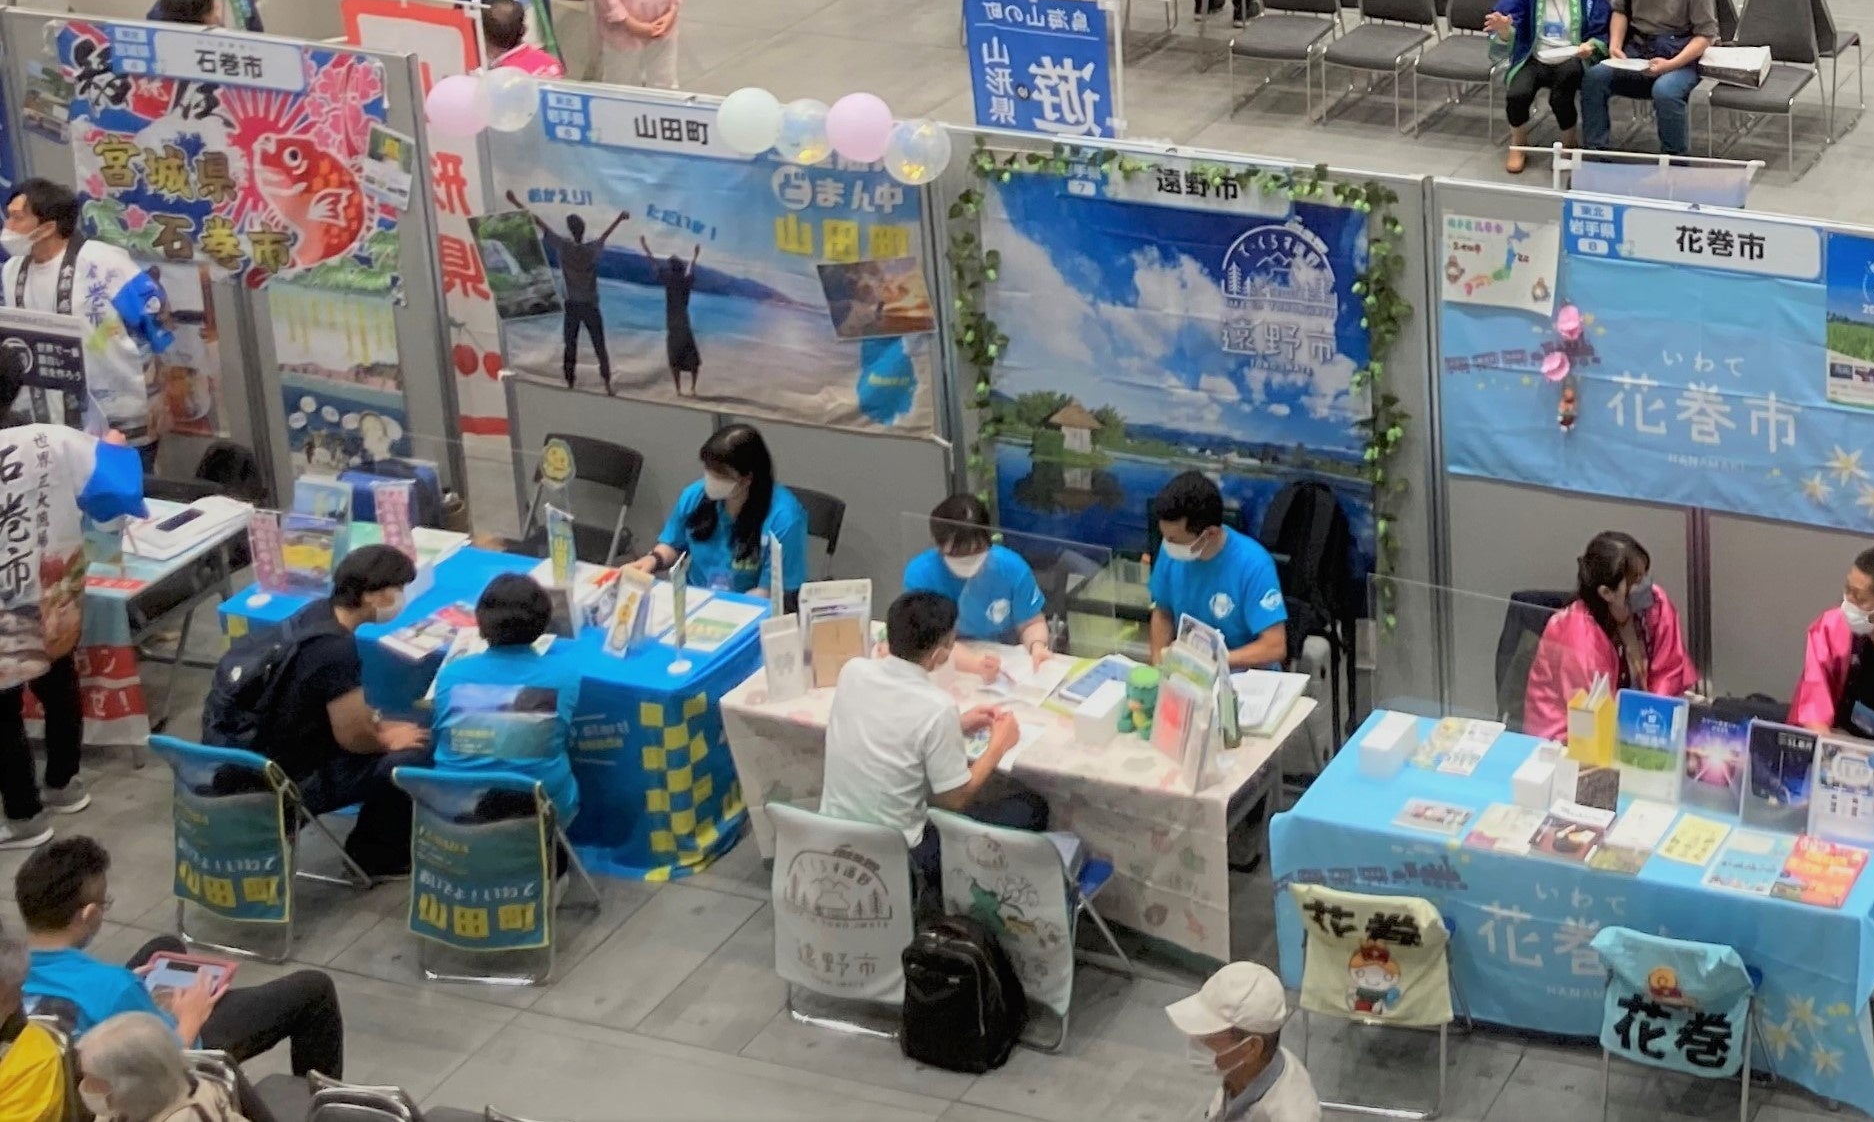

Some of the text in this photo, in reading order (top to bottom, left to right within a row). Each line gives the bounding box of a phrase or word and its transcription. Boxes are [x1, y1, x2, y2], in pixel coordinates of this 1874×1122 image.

[195, 48, 264, 79] 石巻市
[634, 114, 710, 145] 山田町
[93, 134, 238, 204] 宮城県
[1156, 167, 1239, 202] 遠野市
[1581, 204, 1606, 219] 東北
[153, 213, 295, 274] 石巻市
[775, 213, 911, 262] 山田町
[1675, 225, 1767, 261] 花巻市
[1221, 319, 1335, 365] 遠野市
[1661, 348, 1747, 378] いわて
[1606, 372, 1799, 455] 花巻市
[1536, 880, 1627, 915] いわて
[1302, 898, 1422, 948] 花巻
[1611, 991, 1734, 1072] 花巻
